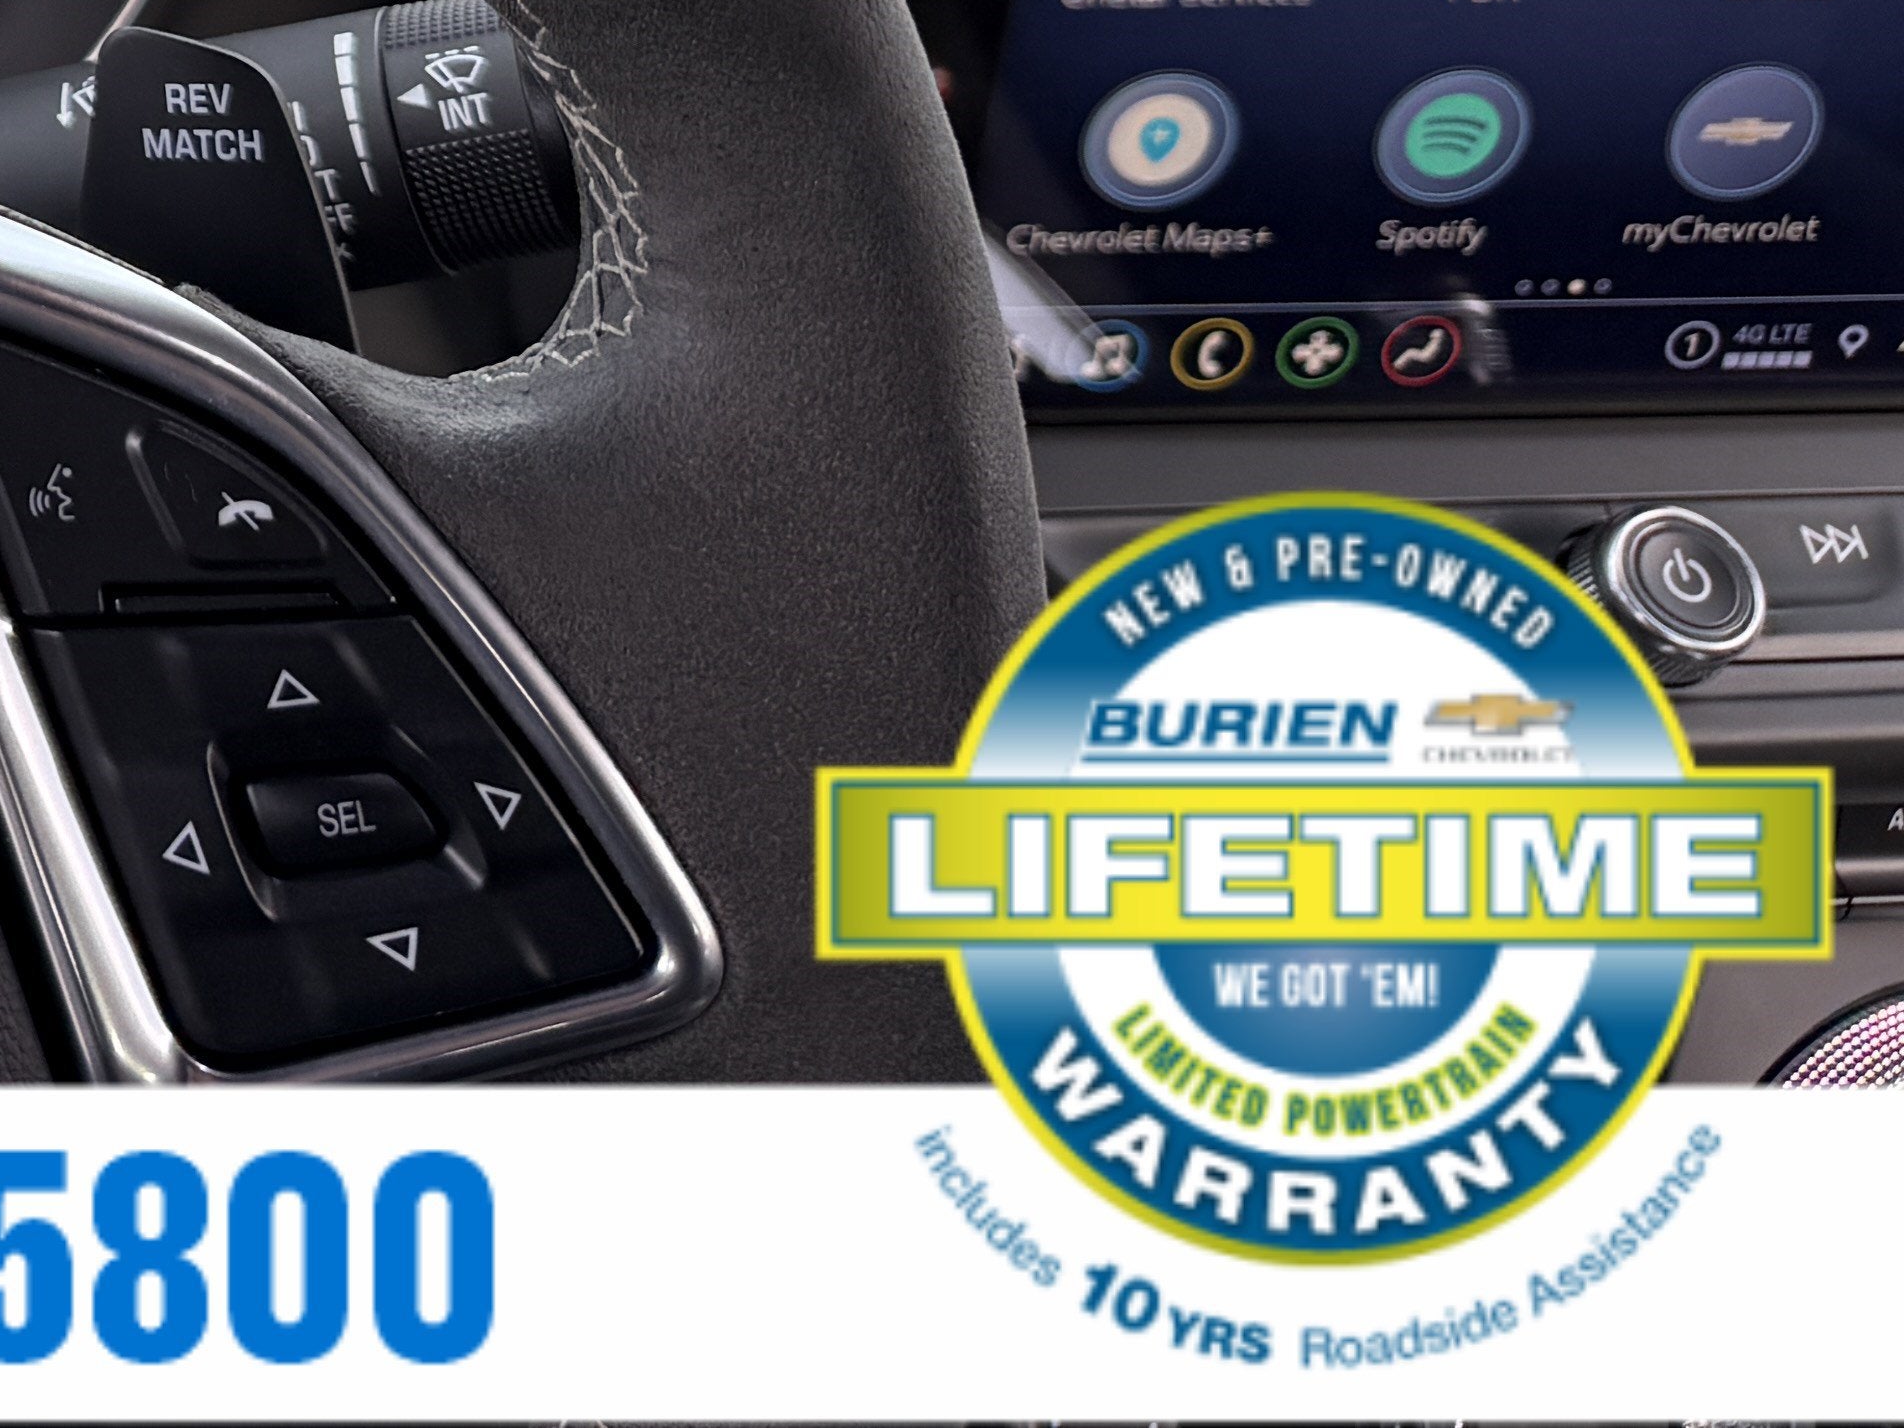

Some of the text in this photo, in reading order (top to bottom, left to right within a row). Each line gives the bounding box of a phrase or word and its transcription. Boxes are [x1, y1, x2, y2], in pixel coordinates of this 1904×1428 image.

[164, 82, 233, 118] REV
[438, 93, 489, 132] INT
[142, 125, 263, 164] MATCH
[1006, 222, 1274, 259] Chevrolet Maps+
[1376, 217, 1488, 257] Spotify
[1622, 214, 1821, 252] myChevrolet
[1732, 323, 1813, 344] 4G LTE
[316, 800, 377, 838] SEL
